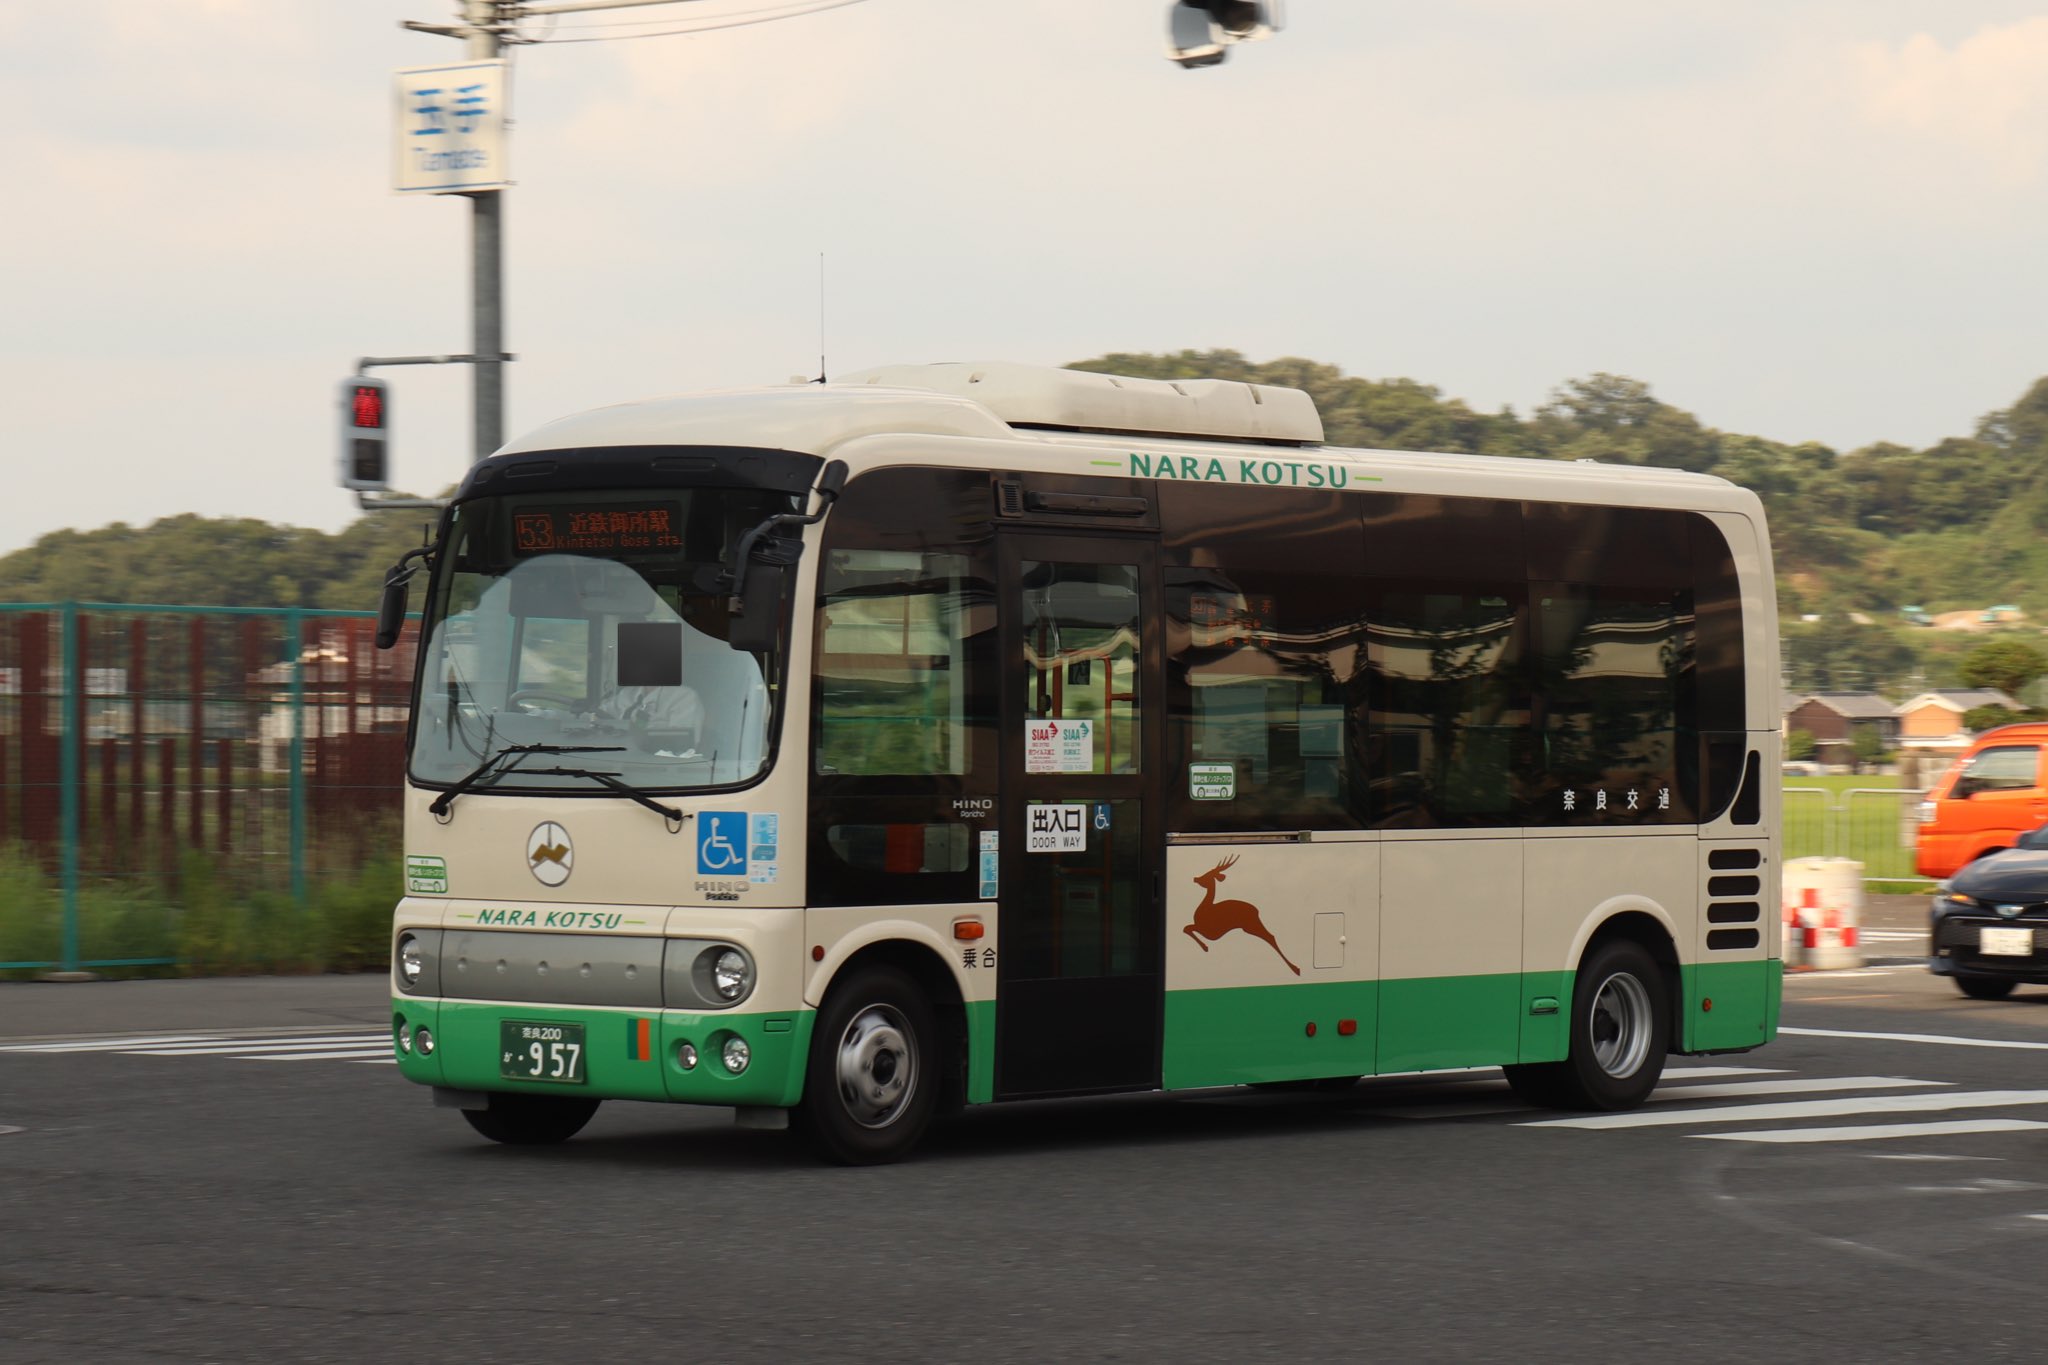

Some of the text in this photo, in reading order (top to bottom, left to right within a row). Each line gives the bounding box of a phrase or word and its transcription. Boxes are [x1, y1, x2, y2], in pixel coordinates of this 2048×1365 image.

[1129, 453, 1347, 488] NARA KOTSU
[569, 510, 670, 534] 近鉄御所駅
[520, 519, 550, 547] 53
[556, 536, 614, 549] Kintetsu
[621, 536, 649, 547] Gose
[1032, 729, 1049, 741] SIAA
[1063, 729, 1080, 741] SIAA
[953, 799, 992, 809] HINO
[1563, 788, 1670, 811] 奈良交通
[1032, 809, 1081, 833] 出入口
[1032, 836, 1081, 848] DOOR WAY
[694, 881, 750, 892] HINO
[476, 909, 622, 929] NARA KOTSU
[963, 948, 996, 969] 乗合
